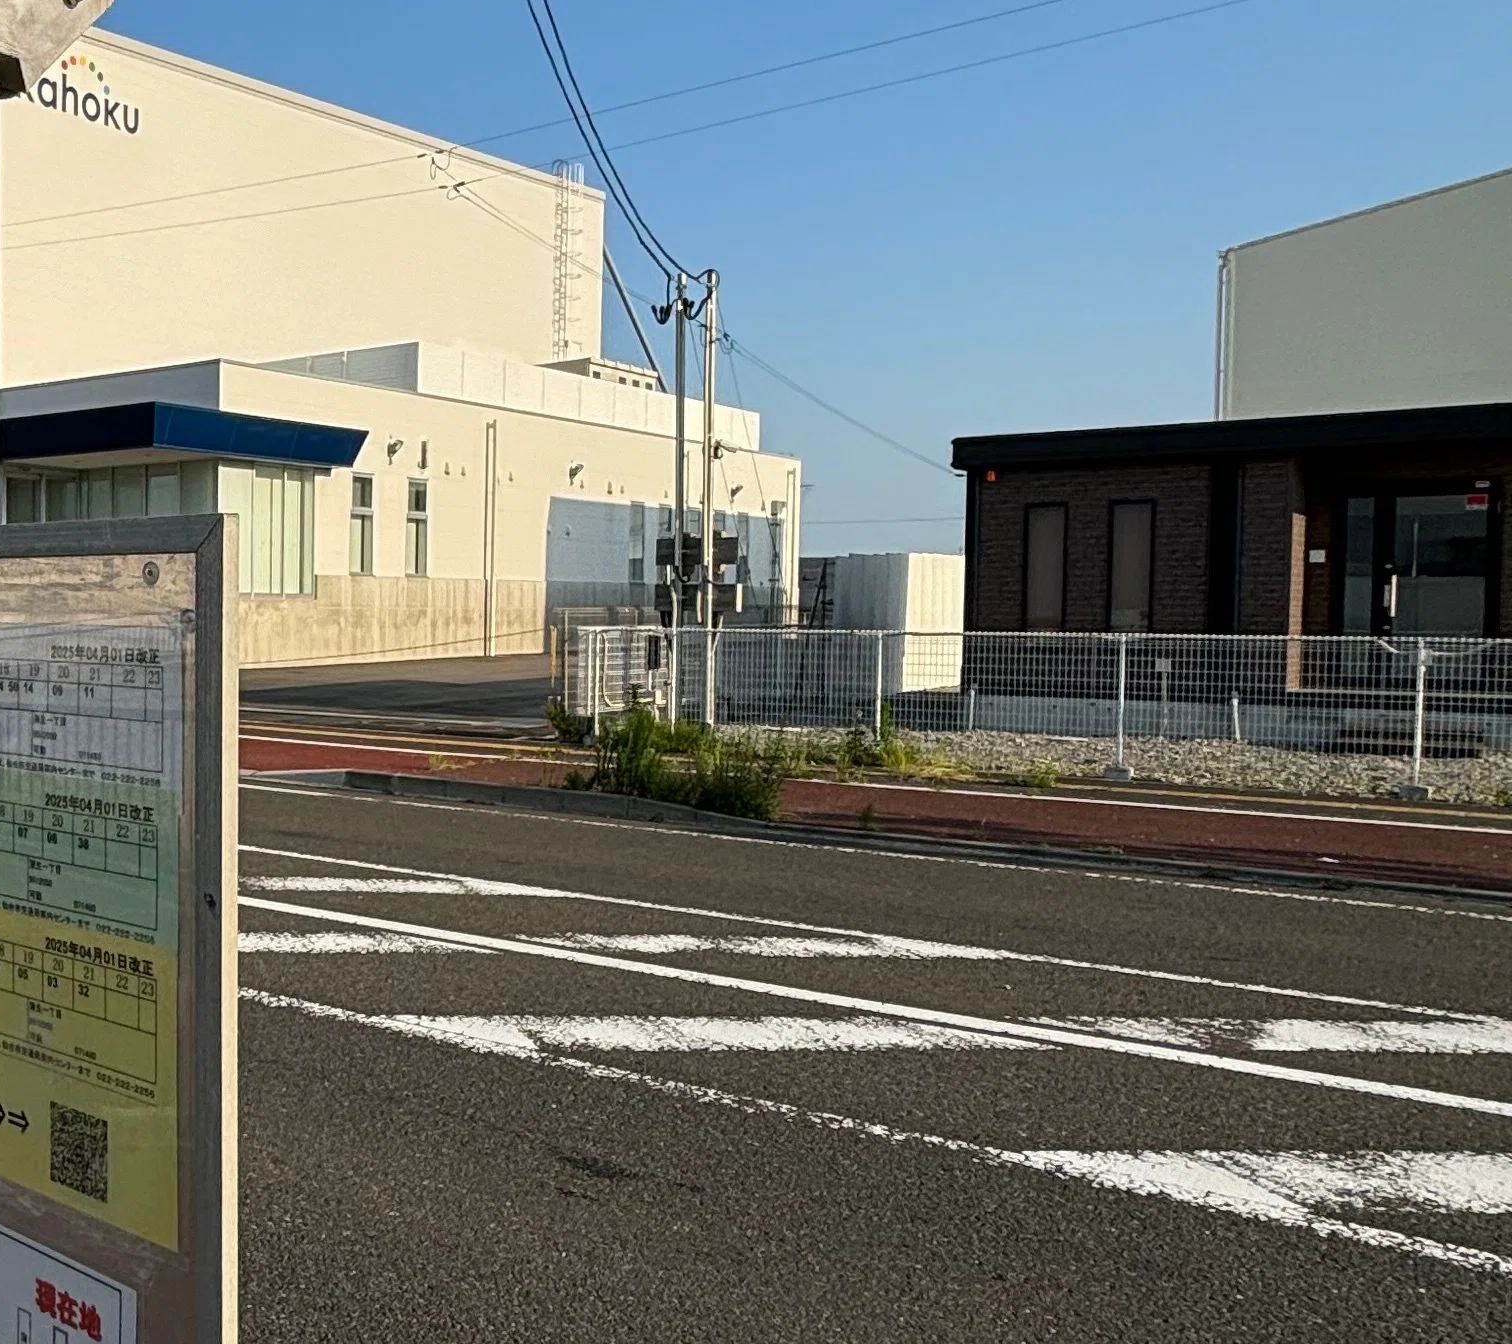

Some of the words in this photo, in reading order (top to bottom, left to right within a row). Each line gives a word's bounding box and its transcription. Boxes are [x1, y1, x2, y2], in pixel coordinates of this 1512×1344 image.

[26, 73, 139, 134] ahoku
[50, 644, 160, 663] 2025年04月01日改正
[30, 663, 40, 676] 19
[57, 665, 69, 678] 20
[89, 667, 101, 681] 21
[123, 669, 135, 683] 22
[148, 670, 160, 684] 23
[24, 681, 33, 694] 14
[84, 686, 94, 698] 11
[45, 793, 154, 822] 2025年04月01日改正
[18, 827, 28, 838] 07
[24, 809, 34, 822] 19
[52, 814, 63, 827] 20
[83, 819, 94, 833] 21
[116, 824, 128, 838] 22
[142, 828, 155, 843] 23
[45, 936, 153, 976] 2025年04月01日改正
[23, 950, 34, 964] 19
[52, 958, 64, 972] 20
[83, 966, 94, 980] 21
[116, 974, 128, 990] 22
[141, 981, 154, 997] 23
[78, 984, 89, 997] 32
[35, 1277, 102, 1343] 現在地
